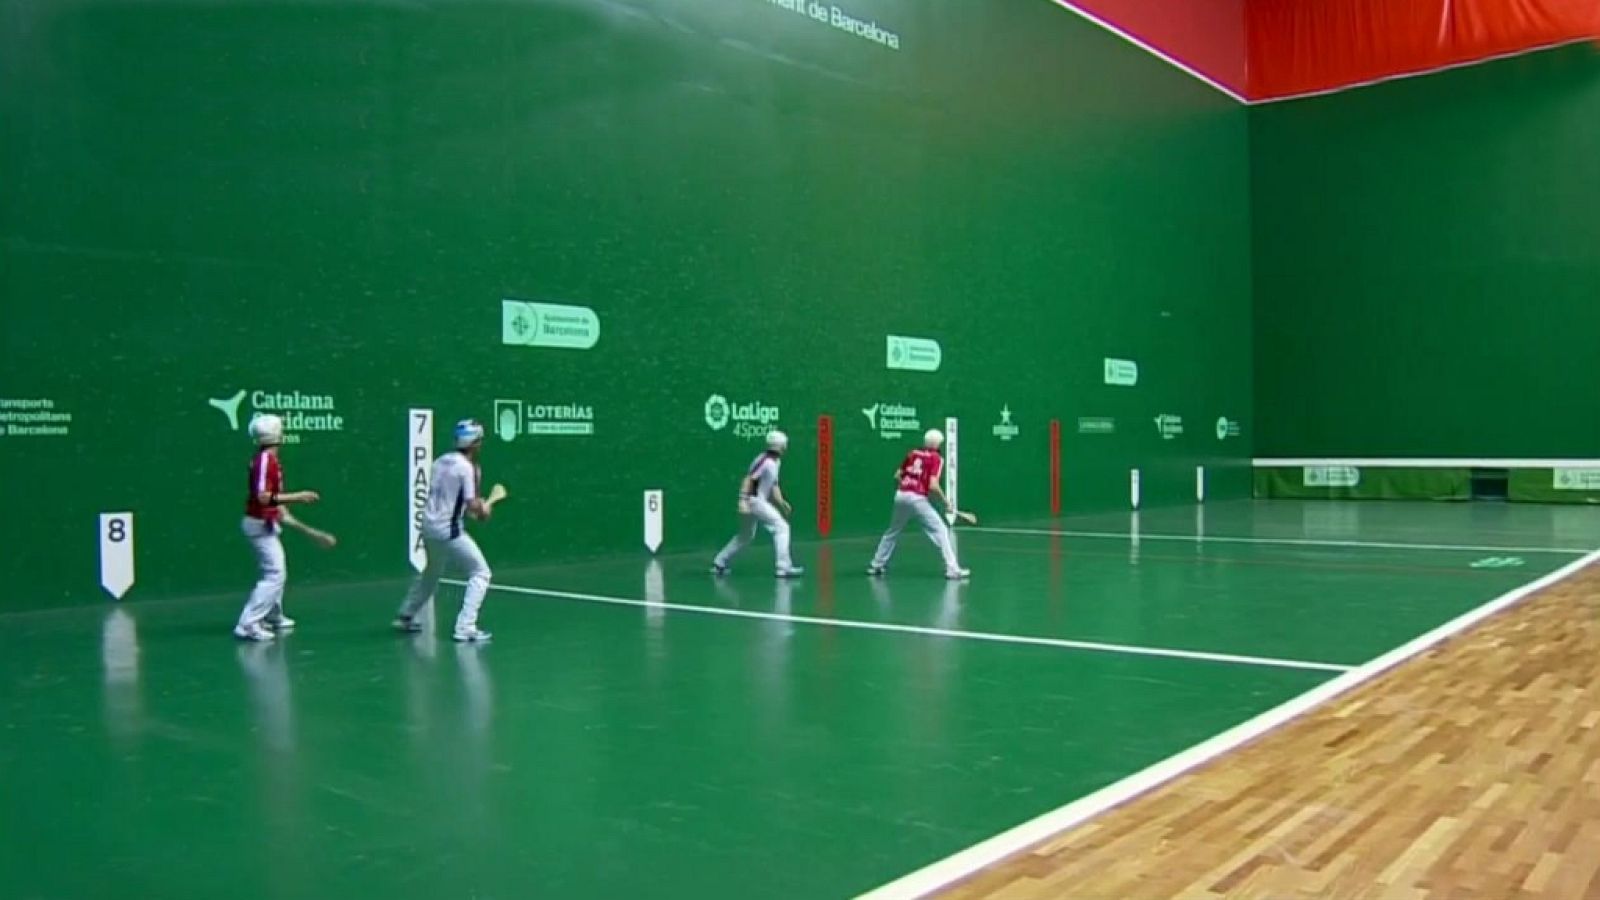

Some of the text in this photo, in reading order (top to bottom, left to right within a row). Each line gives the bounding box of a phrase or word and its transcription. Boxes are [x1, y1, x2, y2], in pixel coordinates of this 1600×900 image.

[809, 0, 828, 22] de
[831, 6, 899, 49] Barcelona
[252, 390, 334, 409] Catalana
[528, 402, 593, 419] LOTERÍAS
[732, 401, 779, 424] LaLiga
[8, 424, 68, 435] Barcelona
[413, 413, 428, 434] 7
[648, 494, 658, 512] 6
[109, 518, 125, 542] 8
